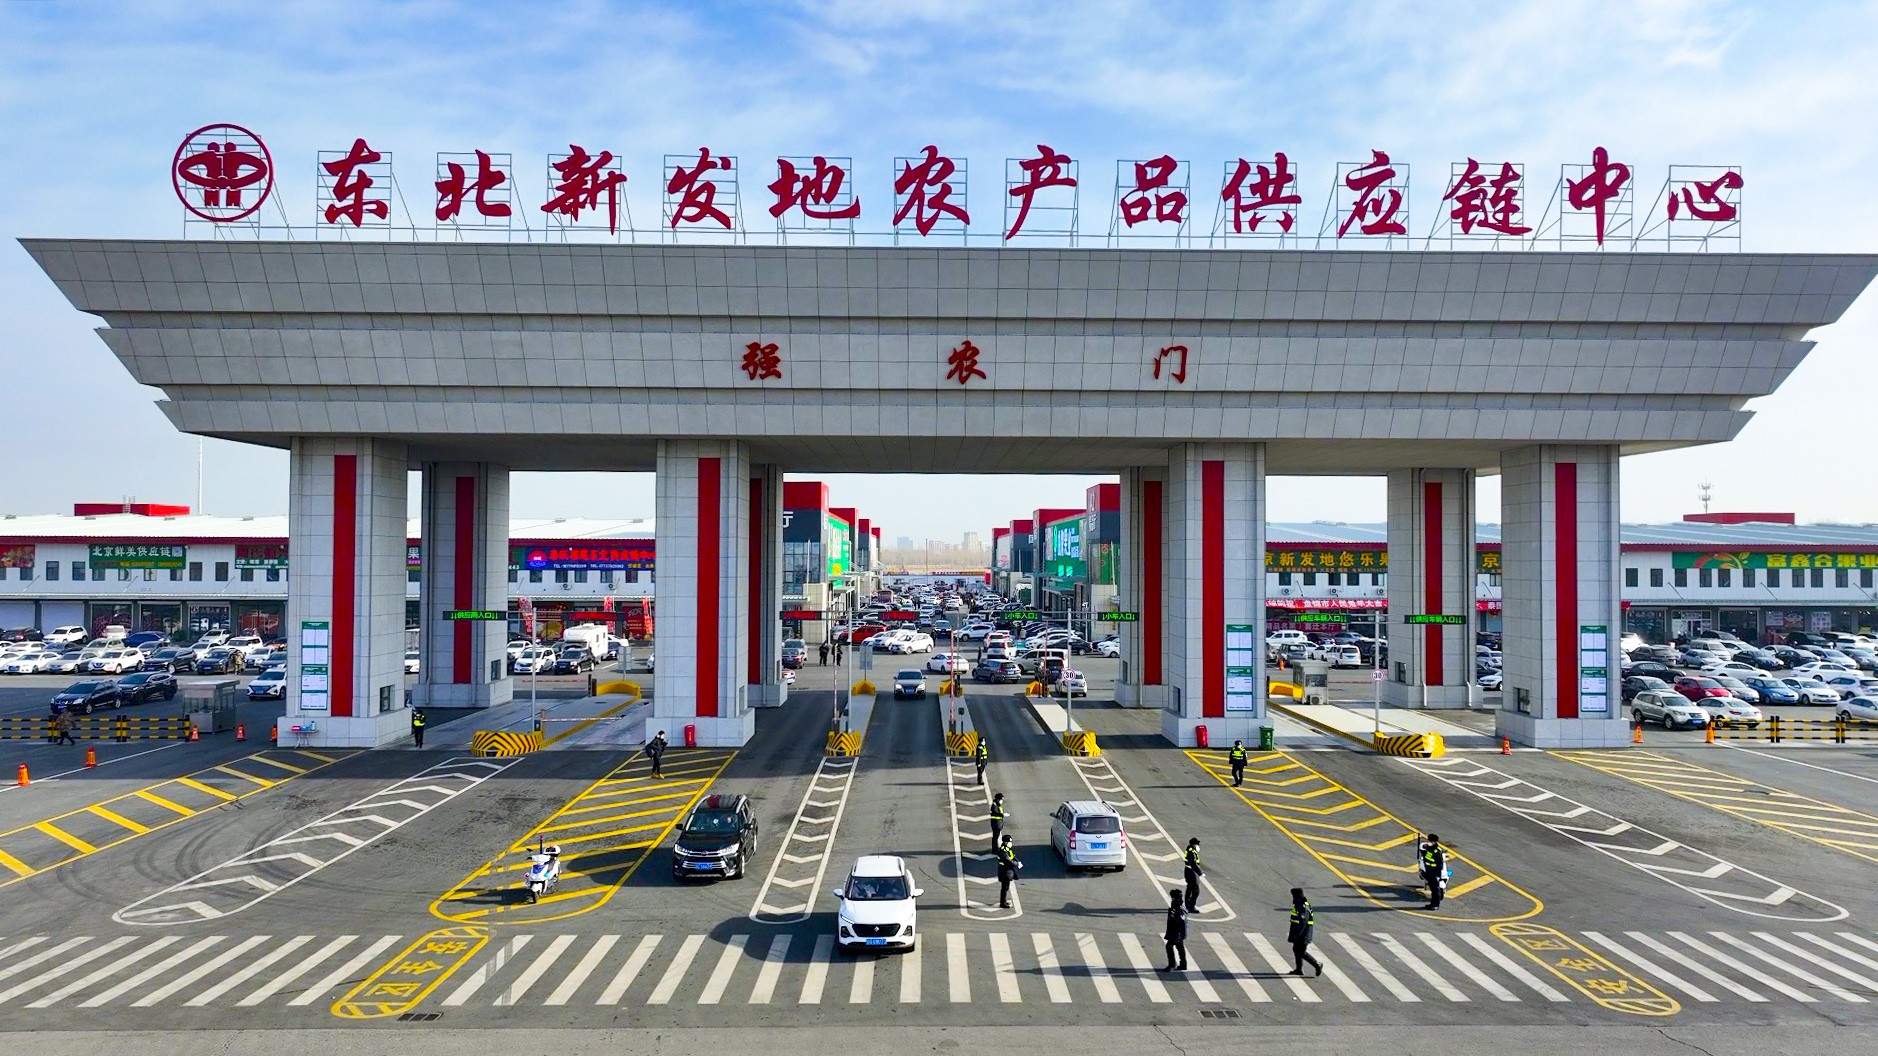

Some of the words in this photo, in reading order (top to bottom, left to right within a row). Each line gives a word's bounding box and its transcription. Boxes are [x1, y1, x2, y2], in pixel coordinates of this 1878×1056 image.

[322, 139, 1743, 246] 东北新发地农产品供应链中心
[741, 340, 1188, 384] 强农门
[92, 545, 171, 557] 北京鲜美供应链
[1482, 552, 1500, 567] 京
[1104, 612, 1132, 620] 小车入口
[1373, 671, 1382, 680] 30
